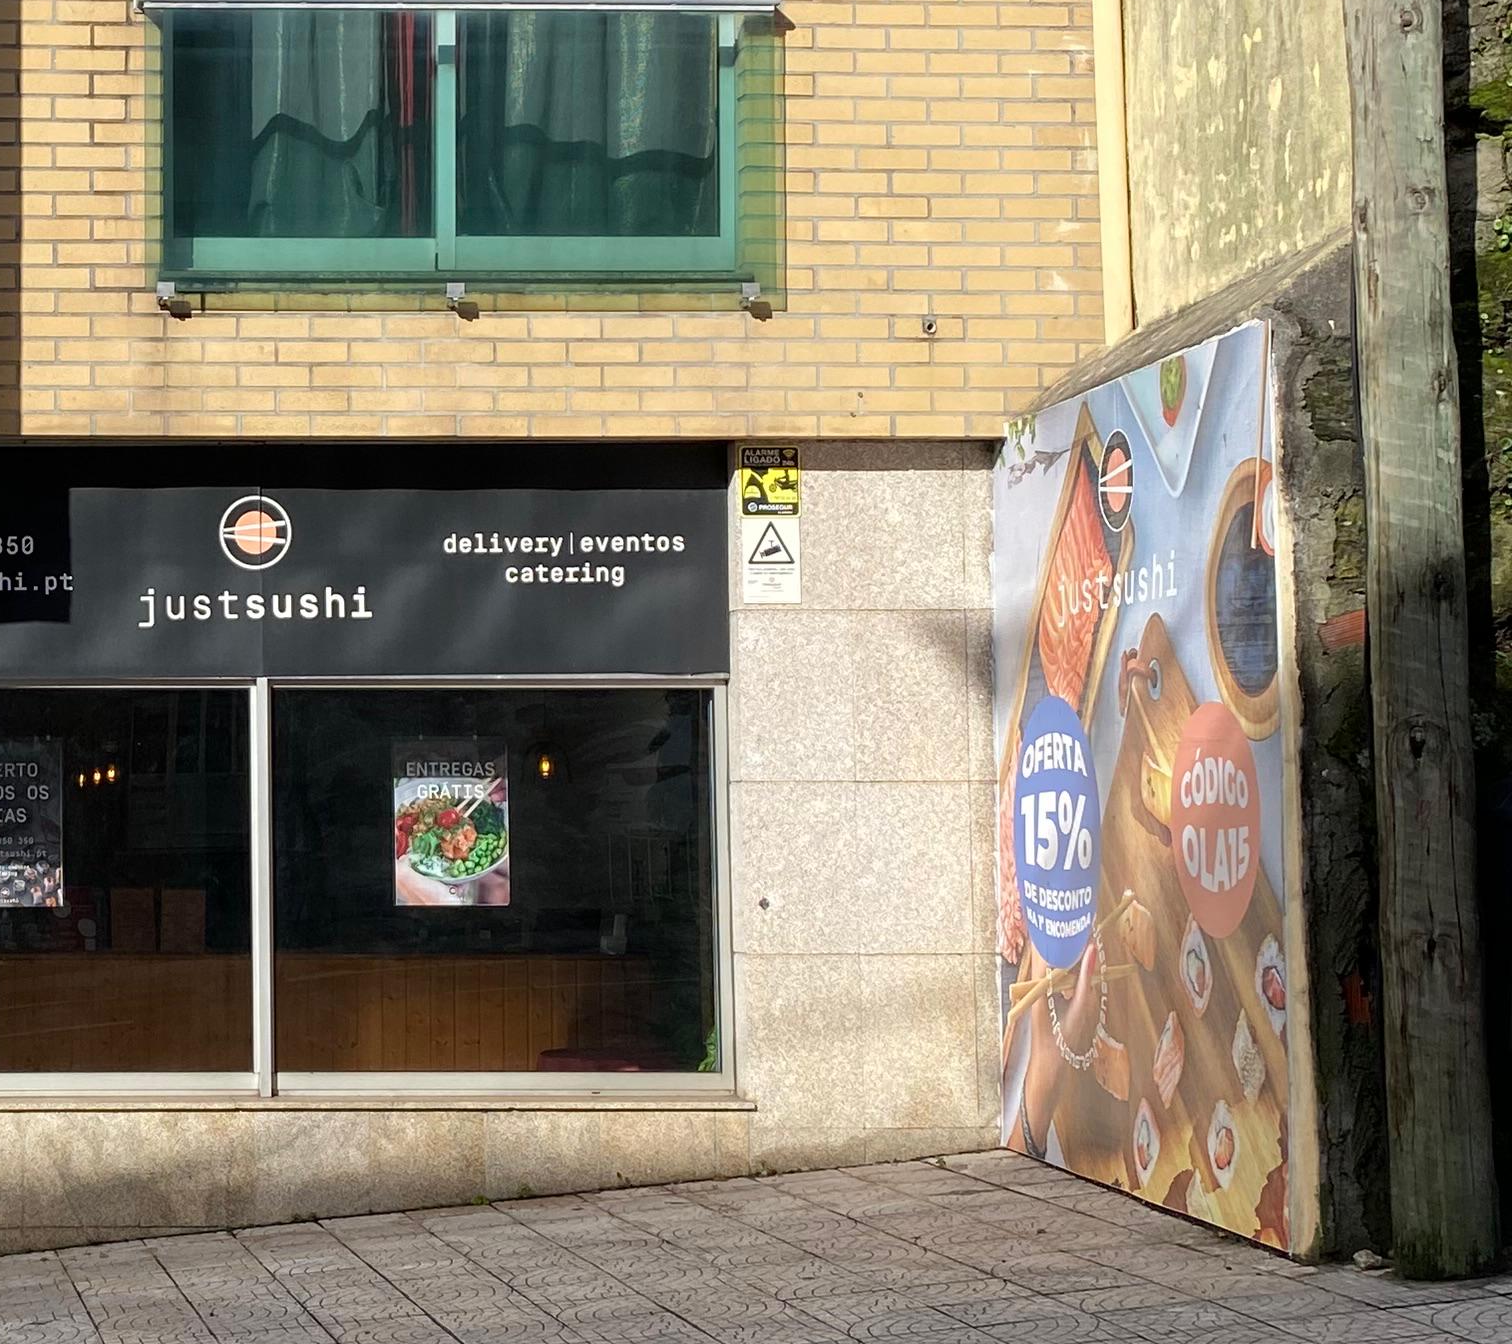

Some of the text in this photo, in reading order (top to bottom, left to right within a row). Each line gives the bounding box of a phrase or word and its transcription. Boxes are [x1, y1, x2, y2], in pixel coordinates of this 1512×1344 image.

[504, 563, 626, 587] catering
[1058, 549, 1178, 628] justsushi
[138, 587, 374, 628] justsushi
[405, 761, 496, 777] ENTREGAS
[1021, 731, 1088, 779] OFERTA
[26, 785, 50, 801] OS
[416, 781, 486, 799] GRÁTIS
[1180, 747, 1249, 809] CÓDIGO
[1020, 789, 1093, 871] 15%
[1182, 824, 1250, 893] OLA15
[1023, 879, 1092, 912] DE DESCONTO
[1045, 911, 1091, 938] ENCOMENDA
